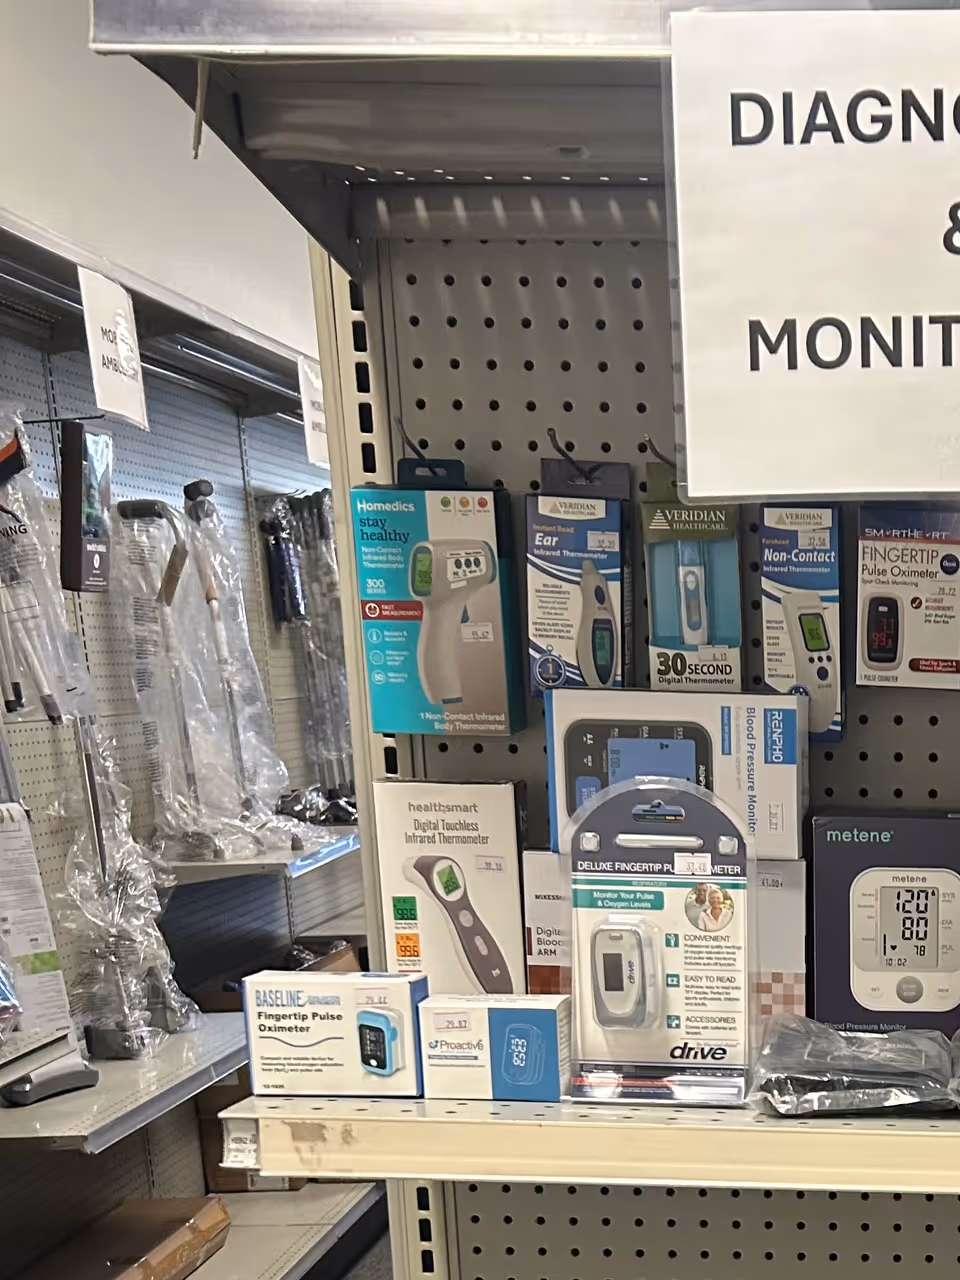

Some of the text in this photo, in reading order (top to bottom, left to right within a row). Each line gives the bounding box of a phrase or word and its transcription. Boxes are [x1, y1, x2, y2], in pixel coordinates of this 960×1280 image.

[357, 500, 415, 512] Homedics
[666, 510, 725, 521] VERIDIAN
[359, 517, 386, 528] stay
[360, 529, 410, 543] healthy
[535, 533, 558, 546] Ear
[764, 549, 835, 562] Non-Contact
[862, 546, 939, 564] FINGERTIP
[862, 565, 939, 579] Pulse Oximeter
[367, 579, 384, 587] 300
[657, 652, 732, 676] 30 SECOND
[659, 676, 683, 685] Digital
[772, 710, 783, 762] RENPHO
[408, 802, 478, 812] healthsmart
[414, 819, 479, 832] Digital Touchless
[405, 832, 489, 845] Infrared Thermometer
[827, 828, 891, 842] metene
[892, 875, 927, 883] metene
[593, 891, 619, 900] Monitor
[620, 892, 635, 900] Your
[256, 990, 304, 1007] BASELINE
[258, 1012, 343, 1022] Fingertip Pulse
[686, 1016, 736, 1024] ACCESSORIES
[259, 1024, 310, 1032] Oximeter
[670, 1042, 727, 1060] drive
